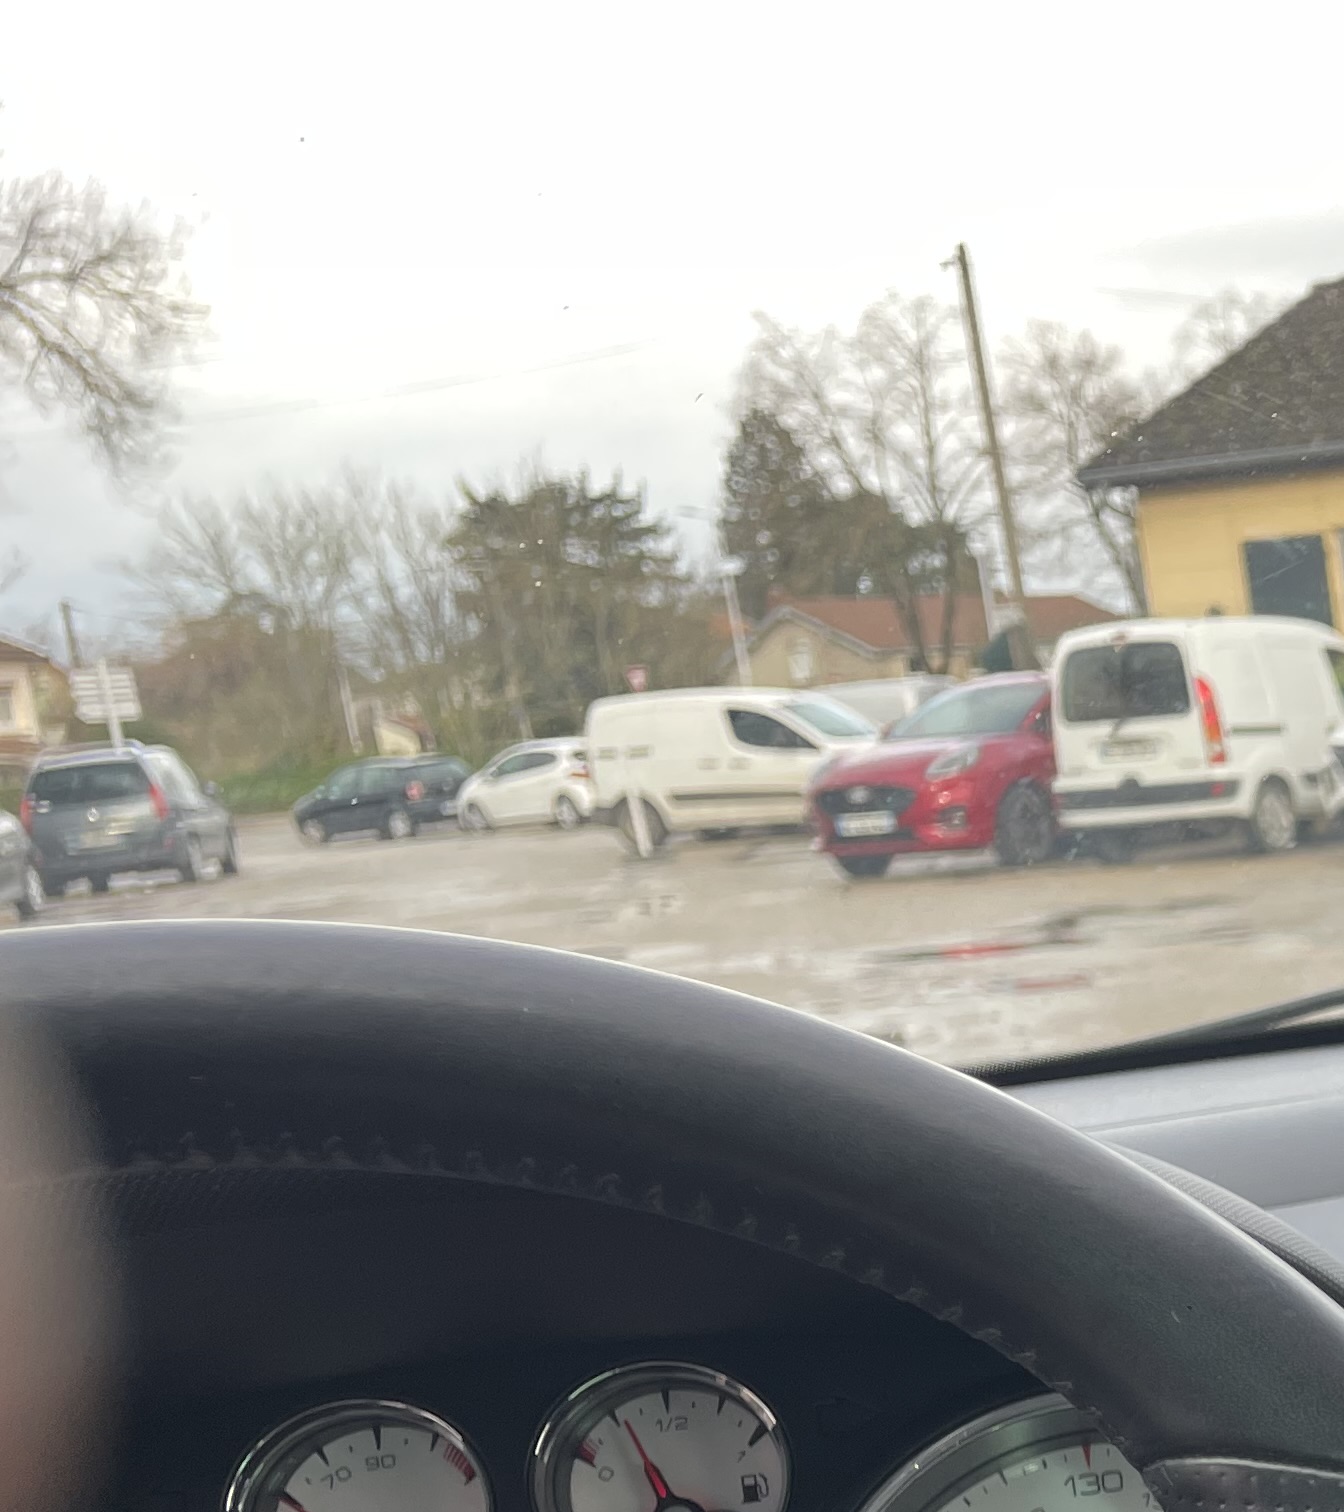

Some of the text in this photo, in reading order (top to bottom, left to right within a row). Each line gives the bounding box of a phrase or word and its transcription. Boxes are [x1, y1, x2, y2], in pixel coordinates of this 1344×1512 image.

[654, 1416, 689, 1433] 1/2
[365, 1453, 397, 1473] 90
[320, 1466, 352, 1491] 70
[1064, 1470, 1124, 1497] 130
